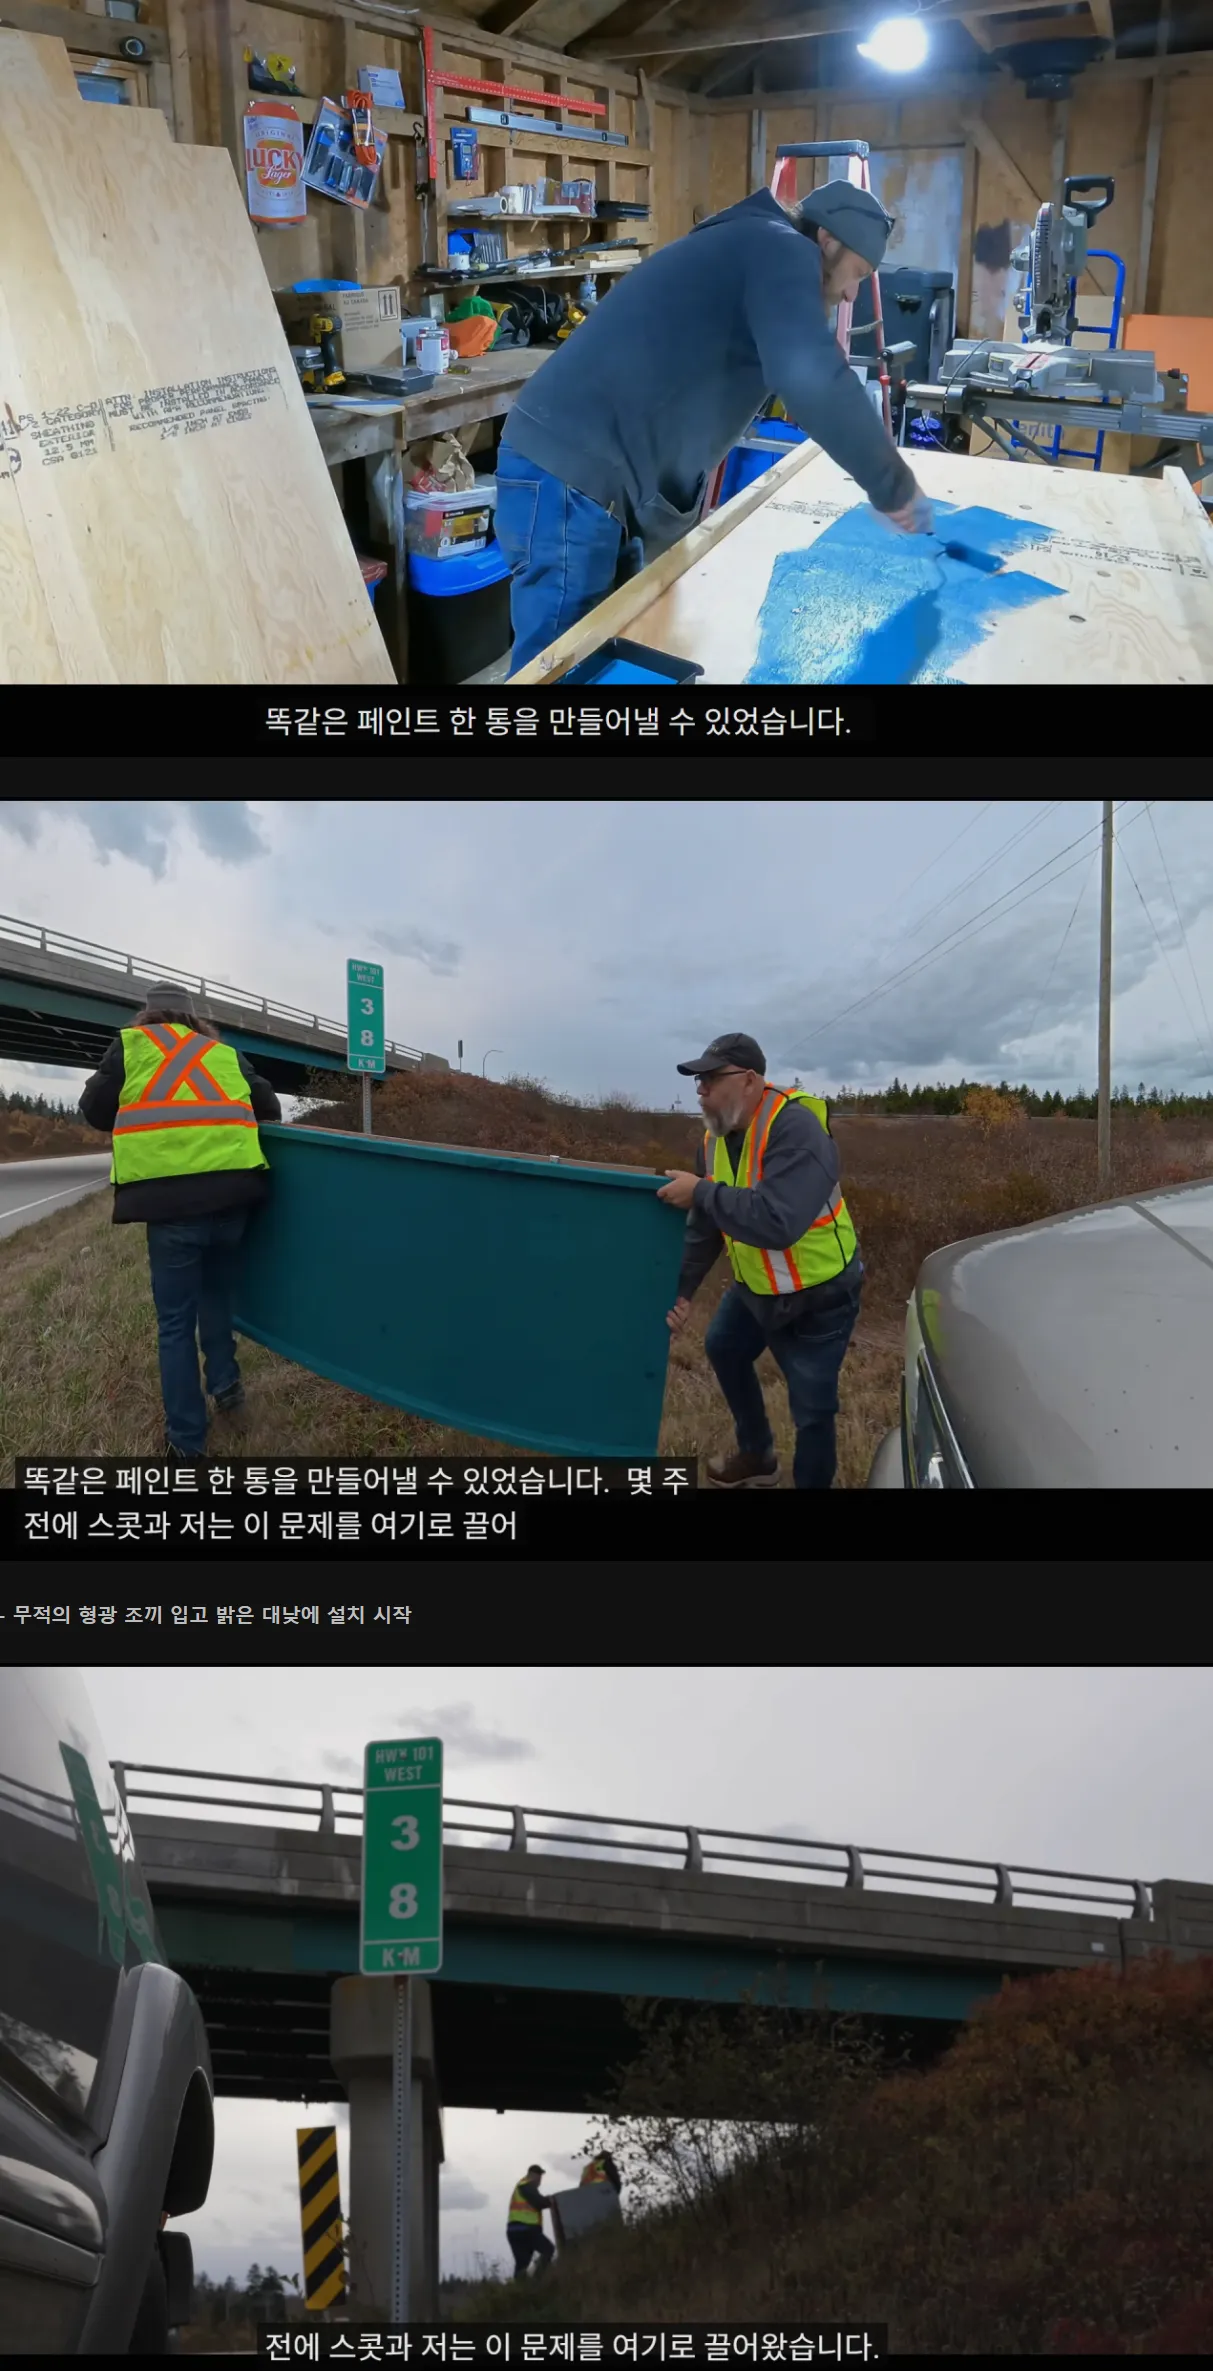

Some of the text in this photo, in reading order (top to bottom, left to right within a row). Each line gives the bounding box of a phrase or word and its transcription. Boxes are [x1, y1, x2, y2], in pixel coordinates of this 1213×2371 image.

[42, 456, 64, 466] CSA
[357, 973, 375, 984] WEST
[361, 998, 374, 1015] 3
[361, 1030, 374, 1047] 8
[412, 1746, 433, 1762] 101
[384, 1765, 423, 1782] WEST
[391, 1815, 420, 1851] 3
[389, 1883, 418, 1919] 8
